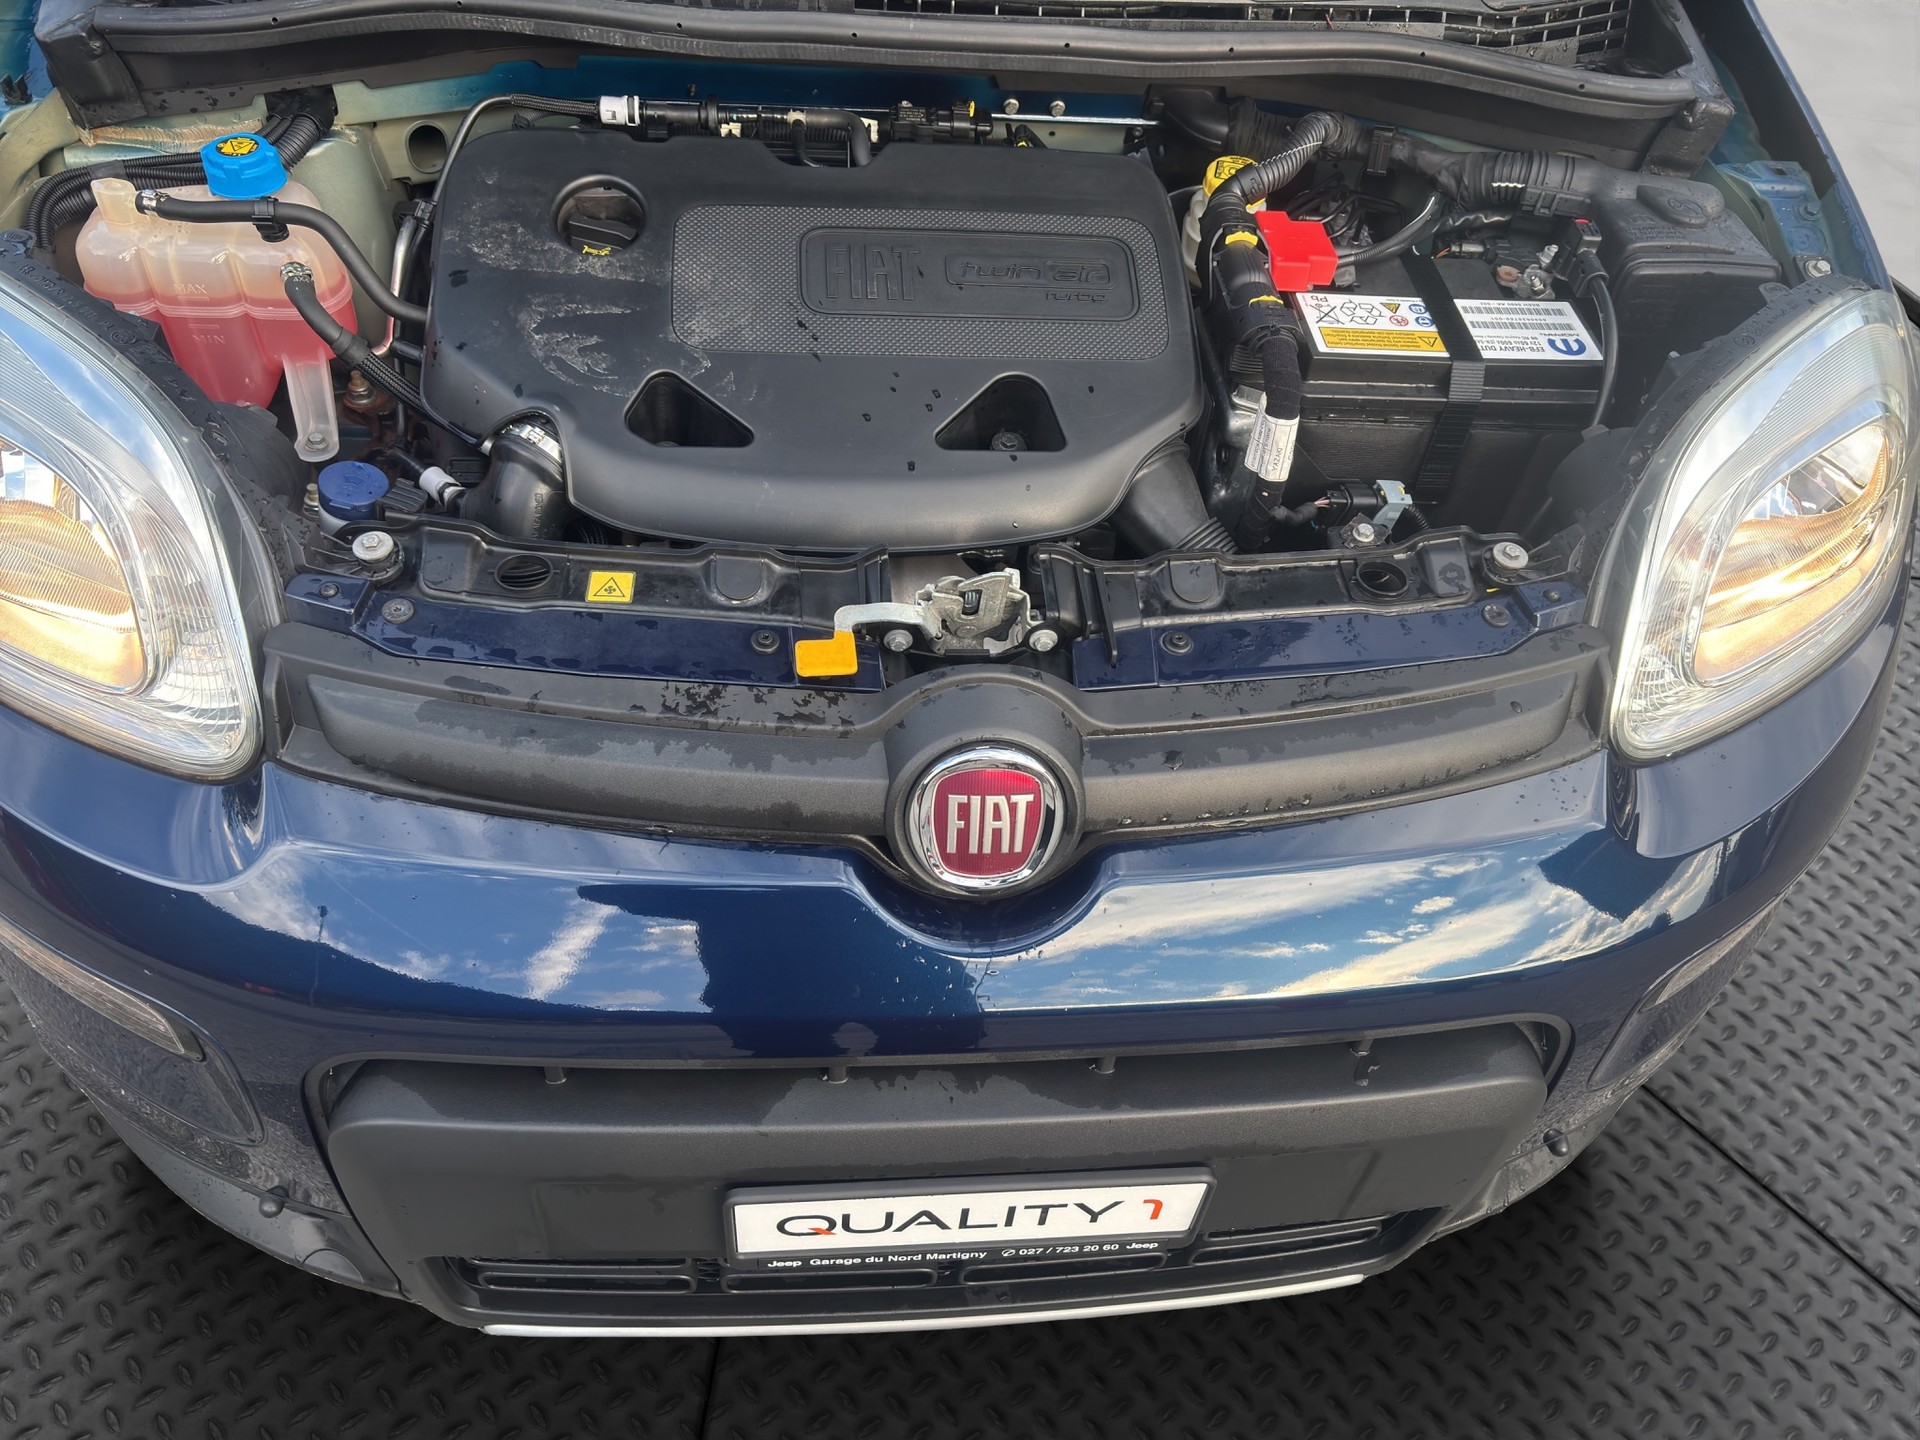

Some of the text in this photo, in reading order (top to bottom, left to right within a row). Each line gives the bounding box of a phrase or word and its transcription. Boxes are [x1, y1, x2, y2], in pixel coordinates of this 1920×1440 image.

[825, 244, 918, 300] FIAT
[173, 283, 207, 295] MAX
[192, 335, 225, 344] MIN
[1271, 447, 1283, 471] YAZAKI
[946, 793, 1035, 854] FIAT
[775, 1199, 1164, 1236] QUALITY 1
[767, 1259, 803, 1268] Jeep
[809, 1257, 861, 1266] Garage
[865, 1255, 884, 1263] du
[887, 1253, 922, 1262] Nord
[926, 1250, 987, 1260] Martigny
[1019, 1247, 1043, 1256] 027
[1055, 1245, 1079, 1253] 723
[1083, 1244, 1100, 1252] 20
[1103, 1243, 1119, 1251] 60
[1126, 1242, 1159, 1250] Jeep
